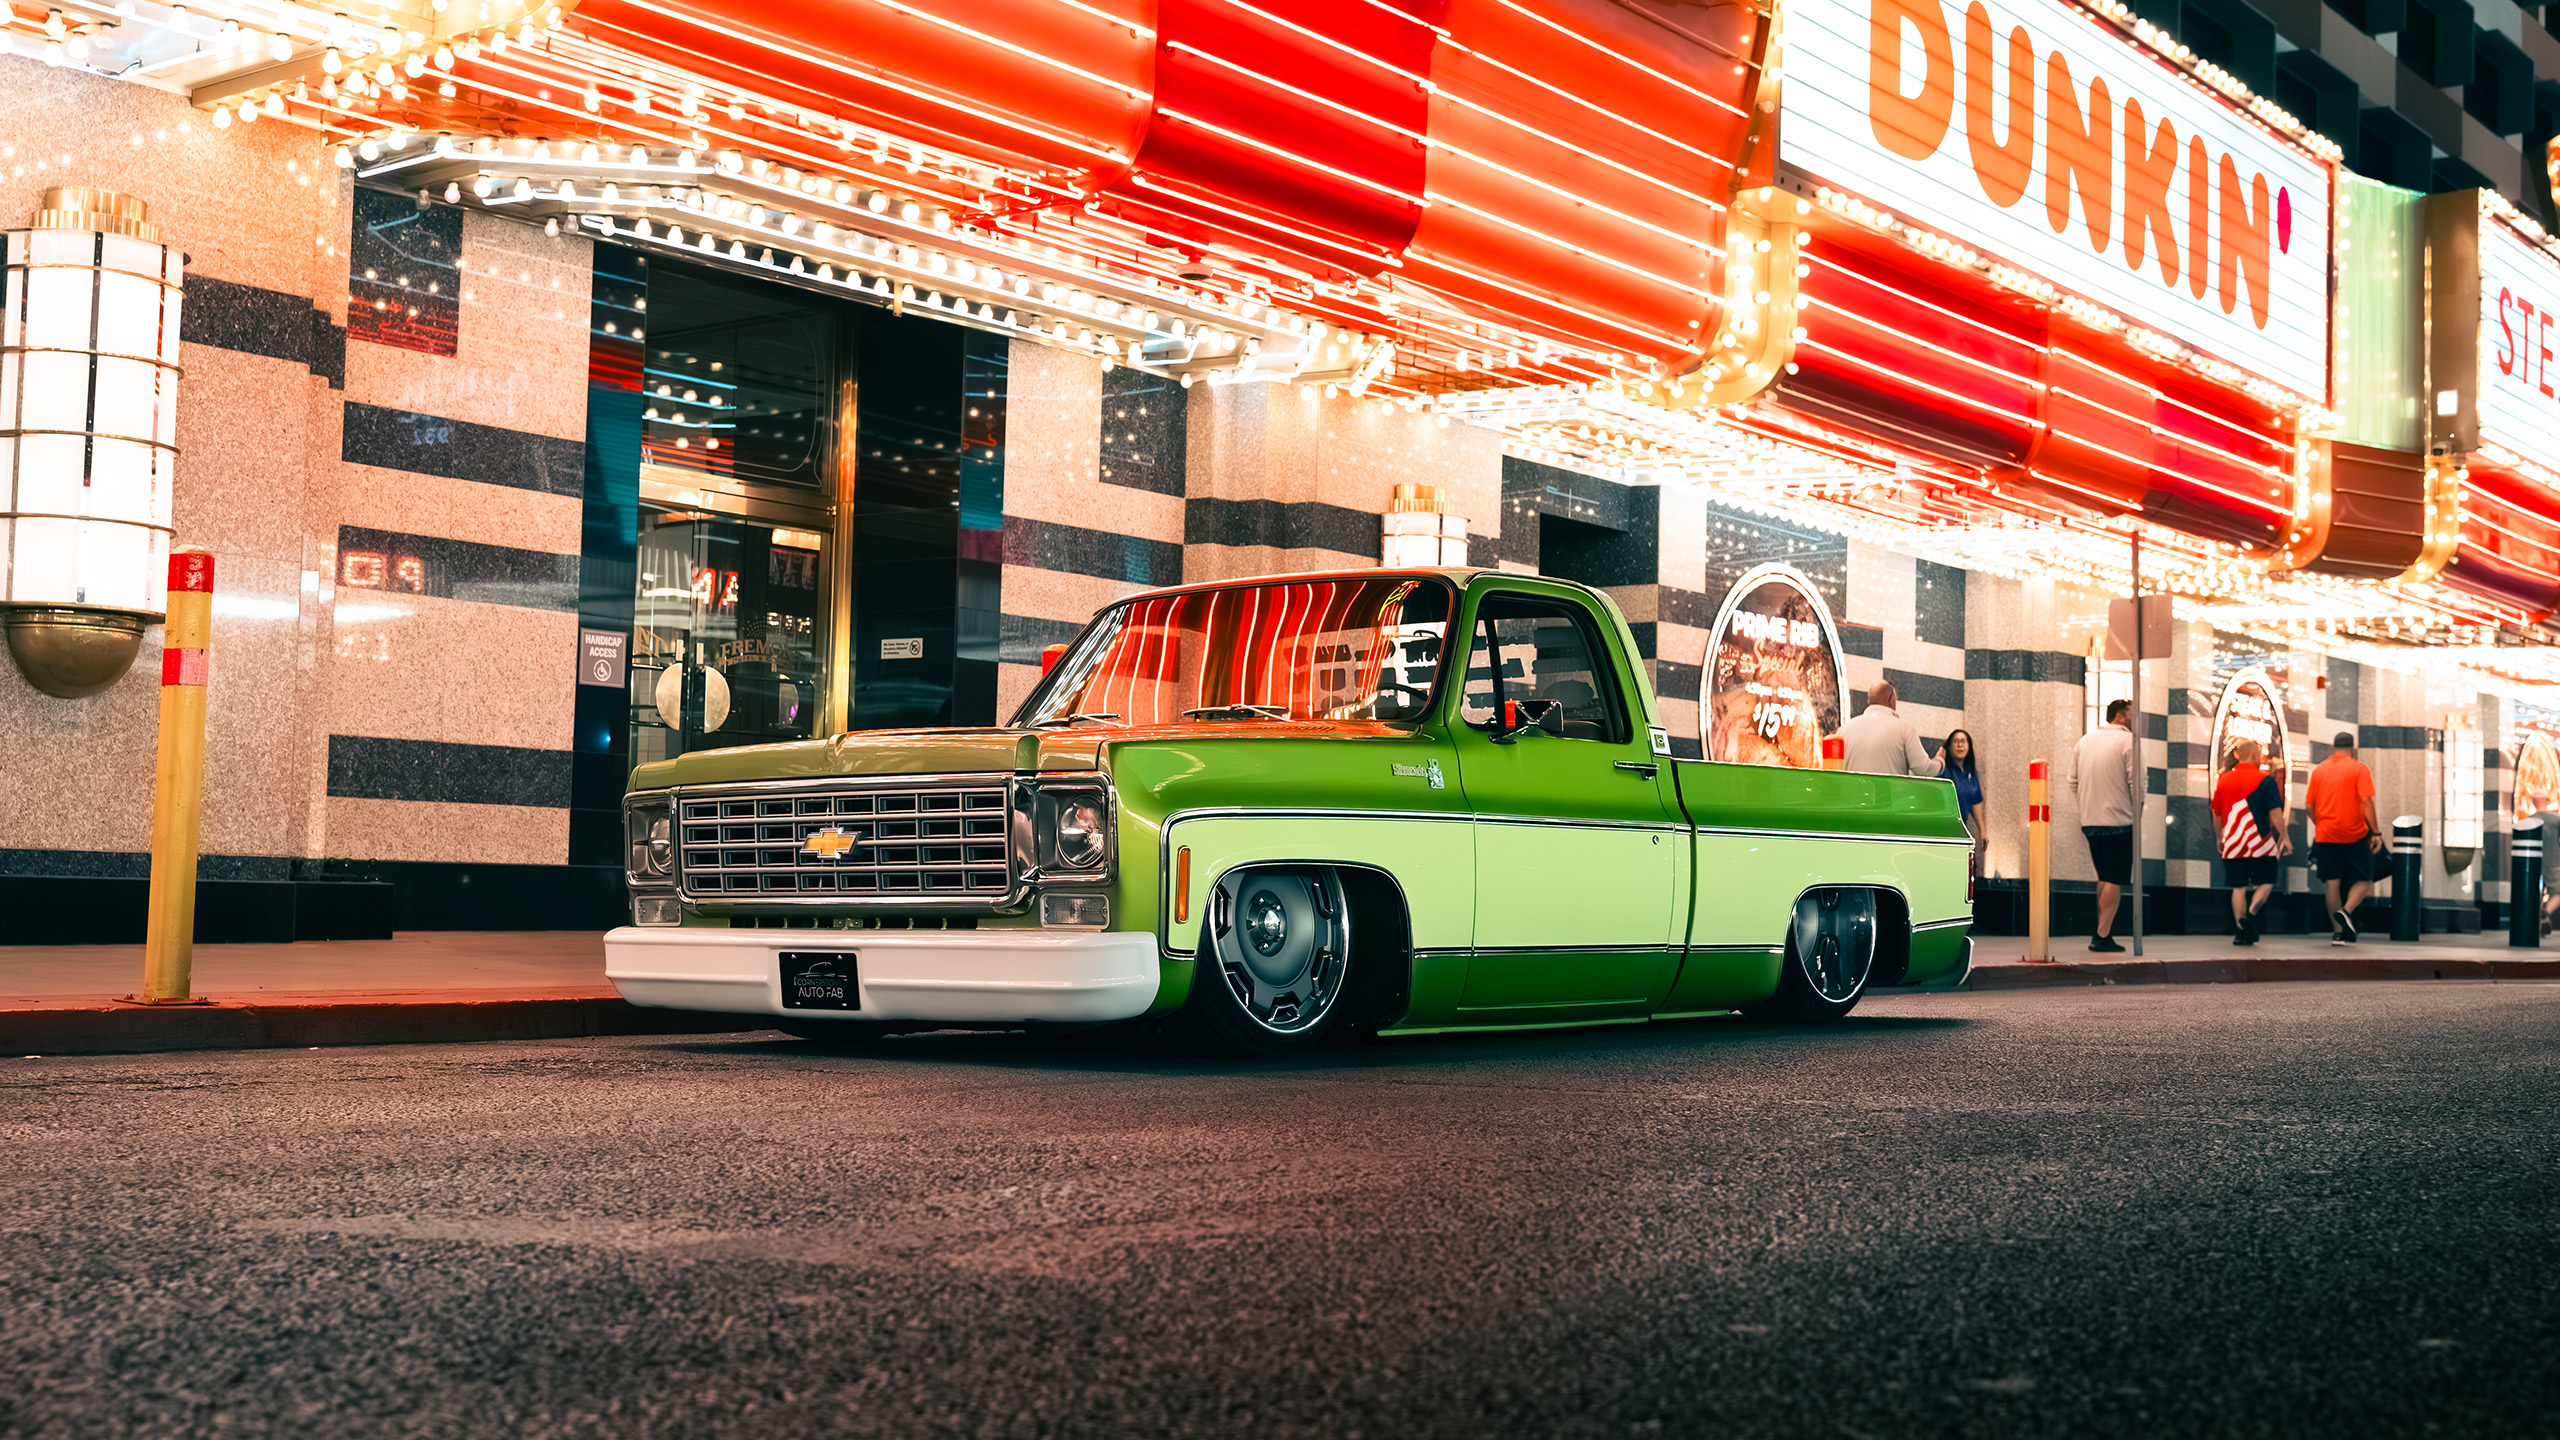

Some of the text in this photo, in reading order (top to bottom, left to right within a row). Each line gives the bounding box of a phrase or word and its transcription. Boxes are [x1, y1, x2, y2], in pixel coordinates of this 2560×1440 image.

[1870, 0, 2291, 330] DUNKIN'
[2498, 286, 2560, 402] STE
[585, 634, 622, 647] HANDICAP
[1732, 609, 1819, 648] PRIME RIB
[589, 646, 617, 658] ACCESS
[720, 639, 792, 661] FREMO
[1753, 638, 1805, 676] Special
[798, 986, 844, 998] AUTO FAB
